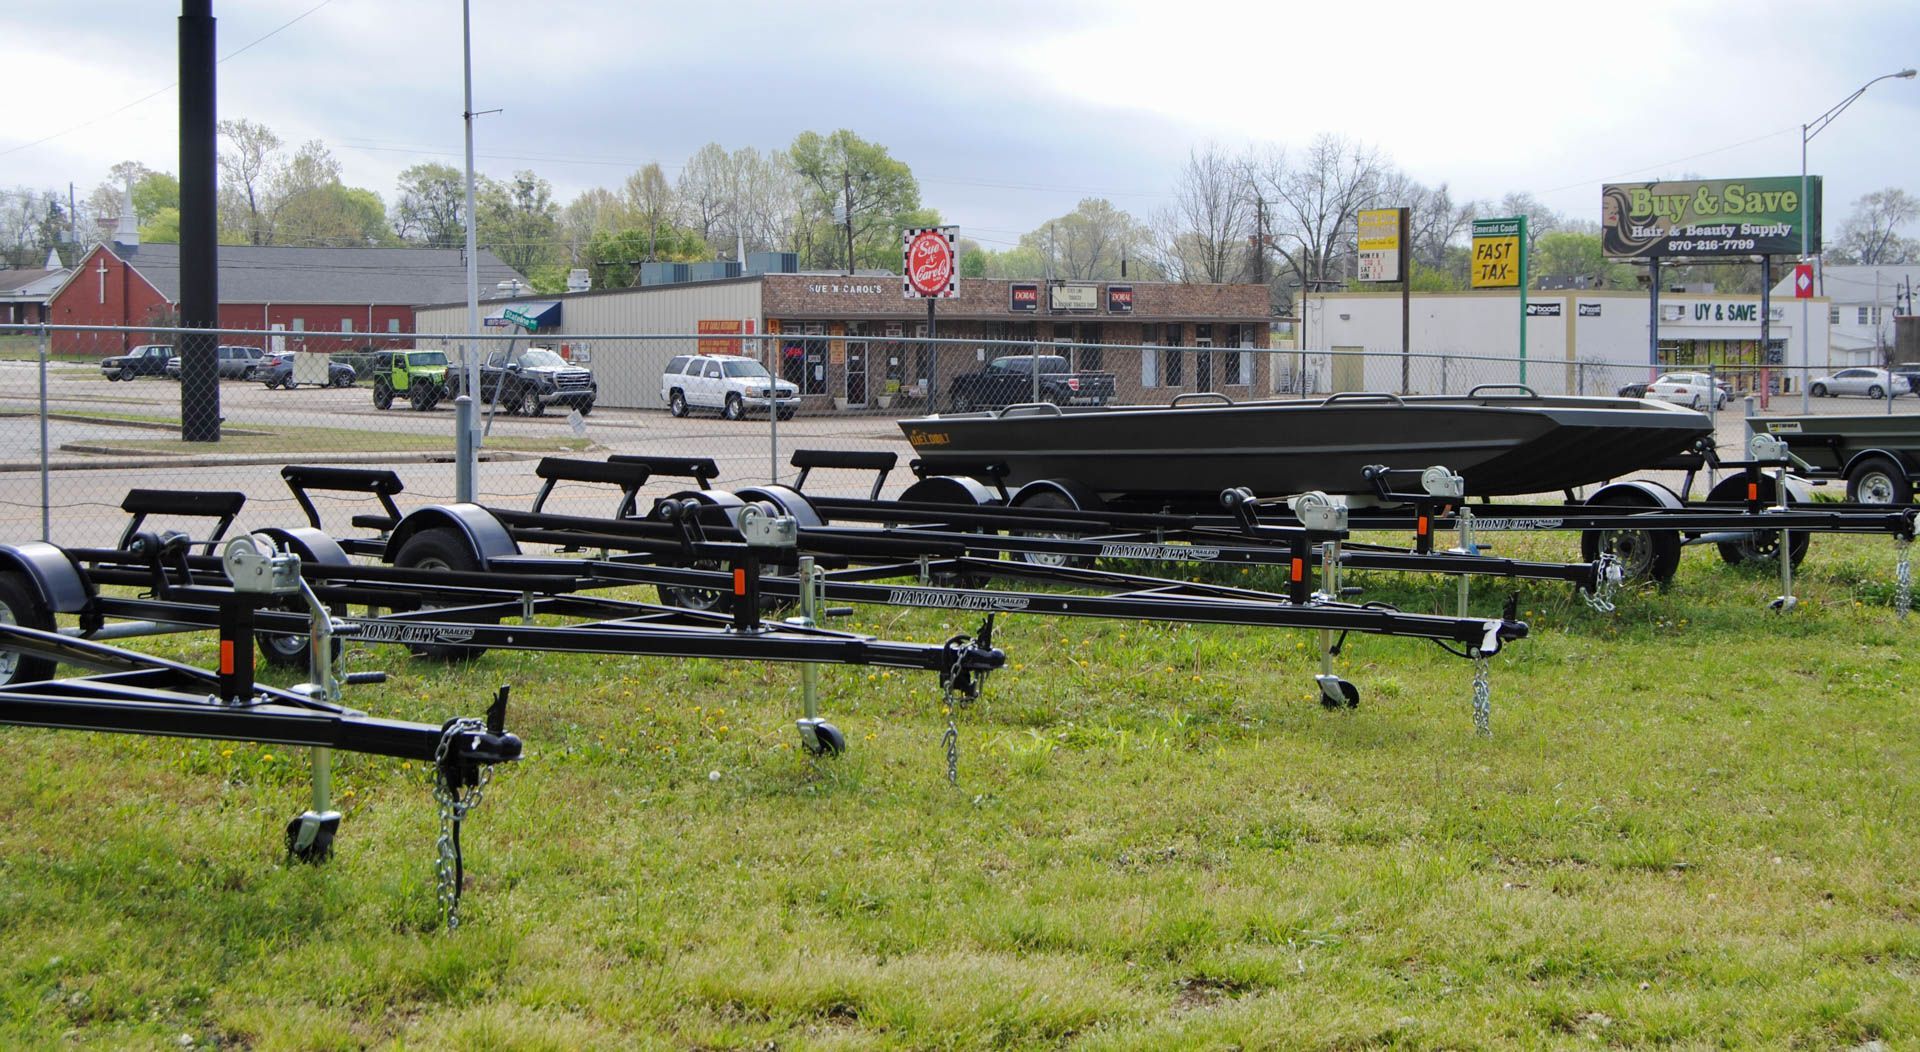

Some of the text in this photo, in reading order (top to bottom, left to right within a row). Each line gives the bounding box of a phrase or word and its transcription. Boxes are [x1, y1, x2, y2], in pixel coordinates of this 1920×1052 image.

[1630, 184, 1798, 223] Buy & Save
[1473, 223, 1518, 233] Emerald Coast
[1632, 222, 1792, 238] Hair & Beauty Supply
[918, 240, 940, 258] Sue
[1477, 243, 1513, 260] FAST
[1669, 239, 1755, 251] 870-216-7799
[1482, 263, 1509, 280] TAX
[809, 284, 827, 293] SUE
[843, 284, 882, 293] CAROL'S
[1015, 290, 1036, 300] DORAL
[1112, 292, 1131, 302] DORAL
[1537, 304, 1560, 313] boost
[1695, 303, 1711, 320] UY
[1715, 304, 1724, 320] &
[1728, 304, 1757, 321] SAVE
[1100, 545, 1161, 558] DIAMOND
[1161, 547, 1191, 560] CITY
[888, 590, 1029, 609] DIAMOND CITY TRAILERS
[401, 625, 440, 643] CITY
[439, 628, 474, 636] TRAILERS
